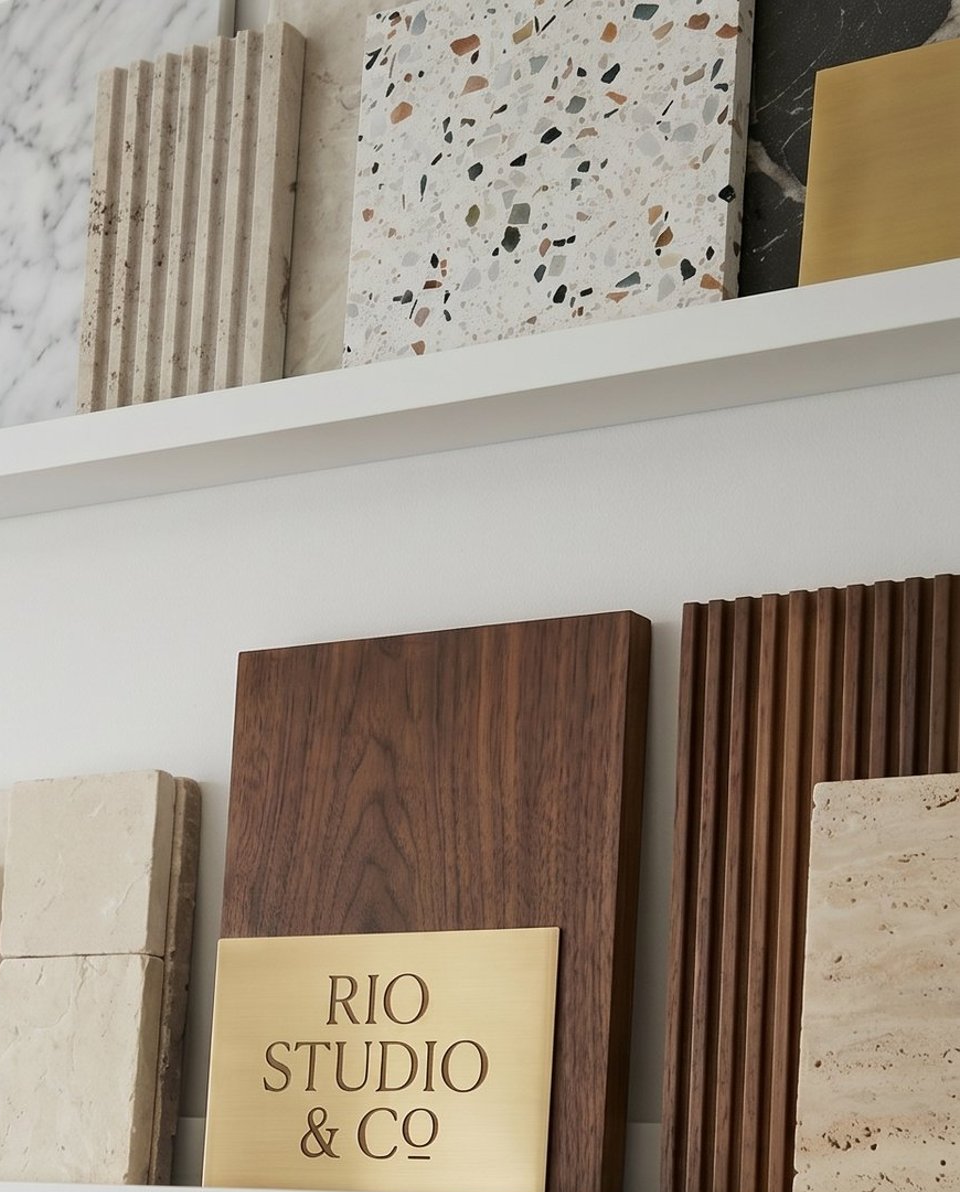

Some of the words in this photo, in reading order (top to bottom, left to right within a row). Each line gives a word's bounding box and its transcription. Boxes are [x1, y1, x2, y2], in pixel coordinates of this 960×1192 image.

[326, 973, 430, 1025] RIO
[263, 1040, 489, 1093] STUDIO
[300, 1106, 341, 1159] &
